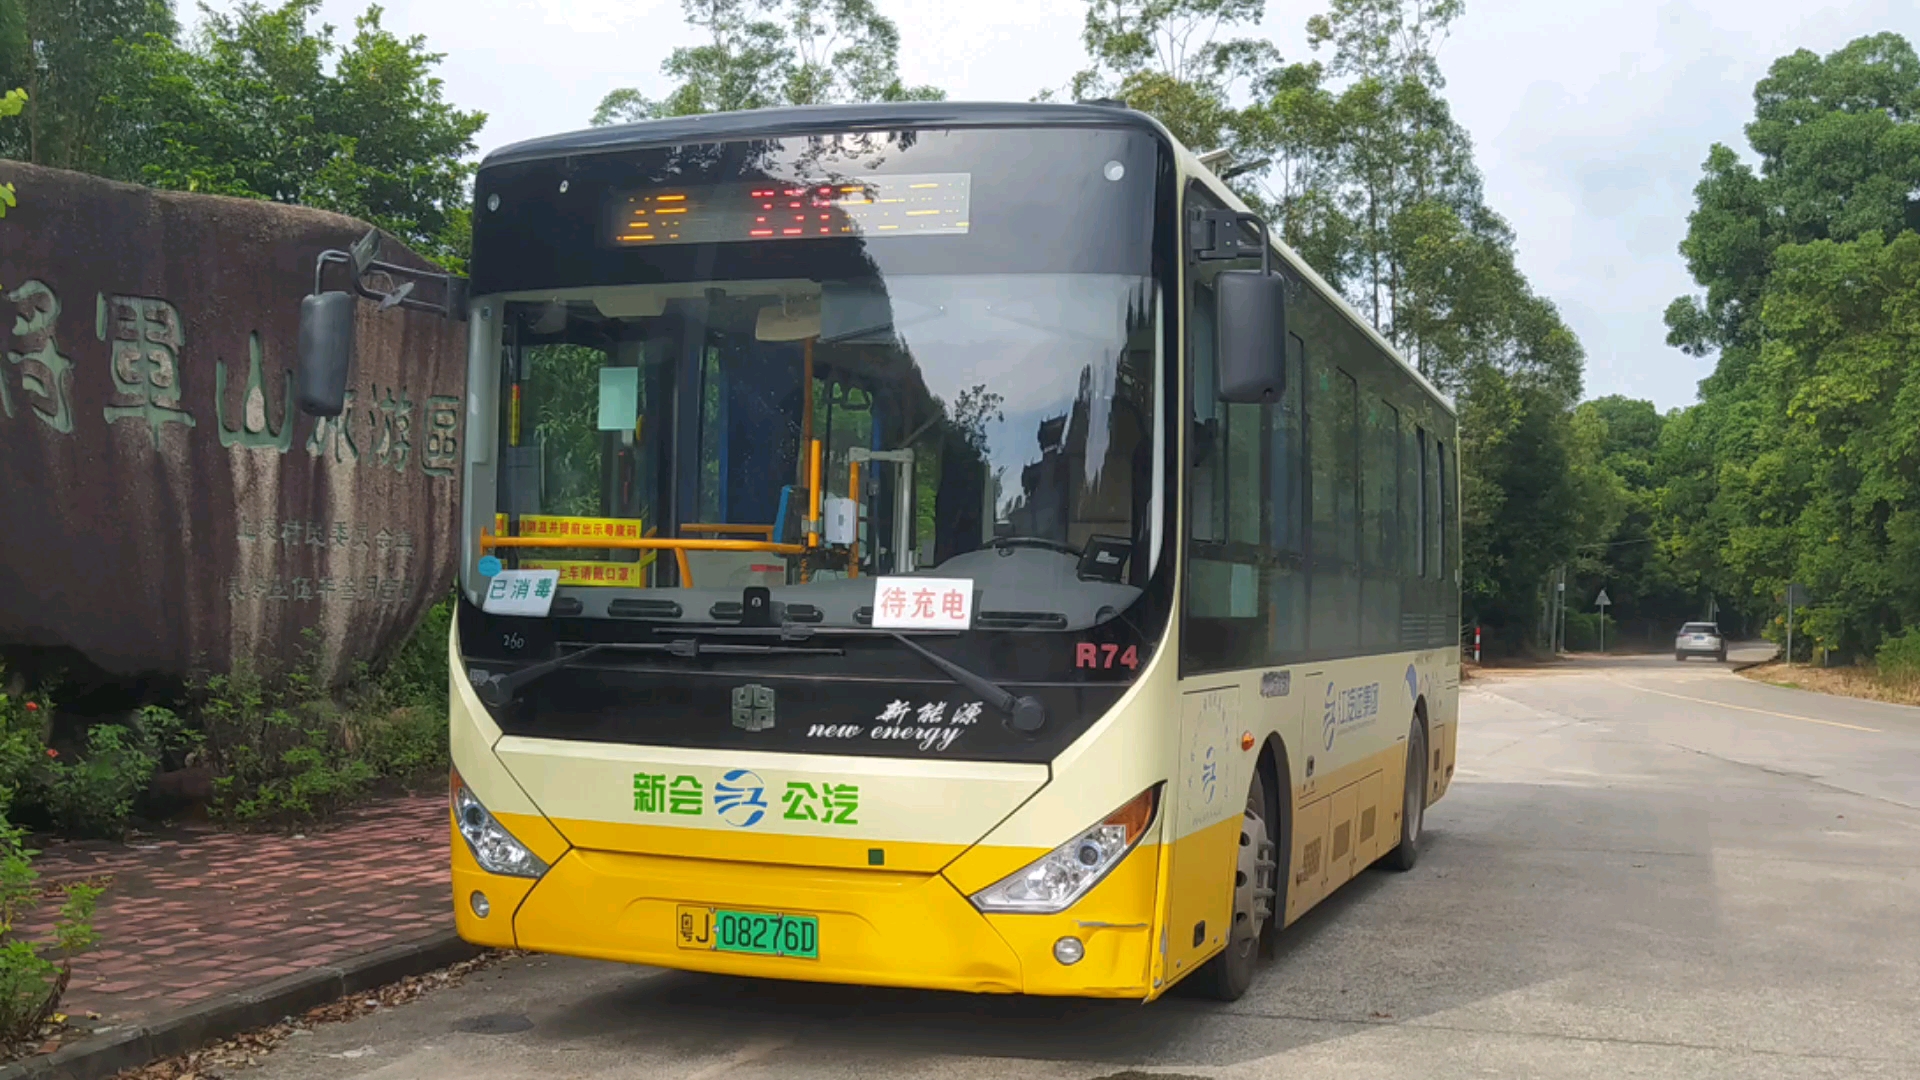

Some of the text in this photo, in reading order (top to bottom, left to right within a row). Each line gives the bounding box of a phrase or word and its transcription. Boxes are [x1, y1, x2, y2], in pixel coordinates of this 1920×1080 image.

[490, 577, 553, 600] 已消毒
[880, 587, 966, 620] 待充电
[1076, 643, 1139, 670] R74
[875, 699, 984, 727] 新能源
[806, 723, 965, 752] new energy
[633, 772, 859, 825] 新会 公汽
[722, 914, 815, 953] 08276D
